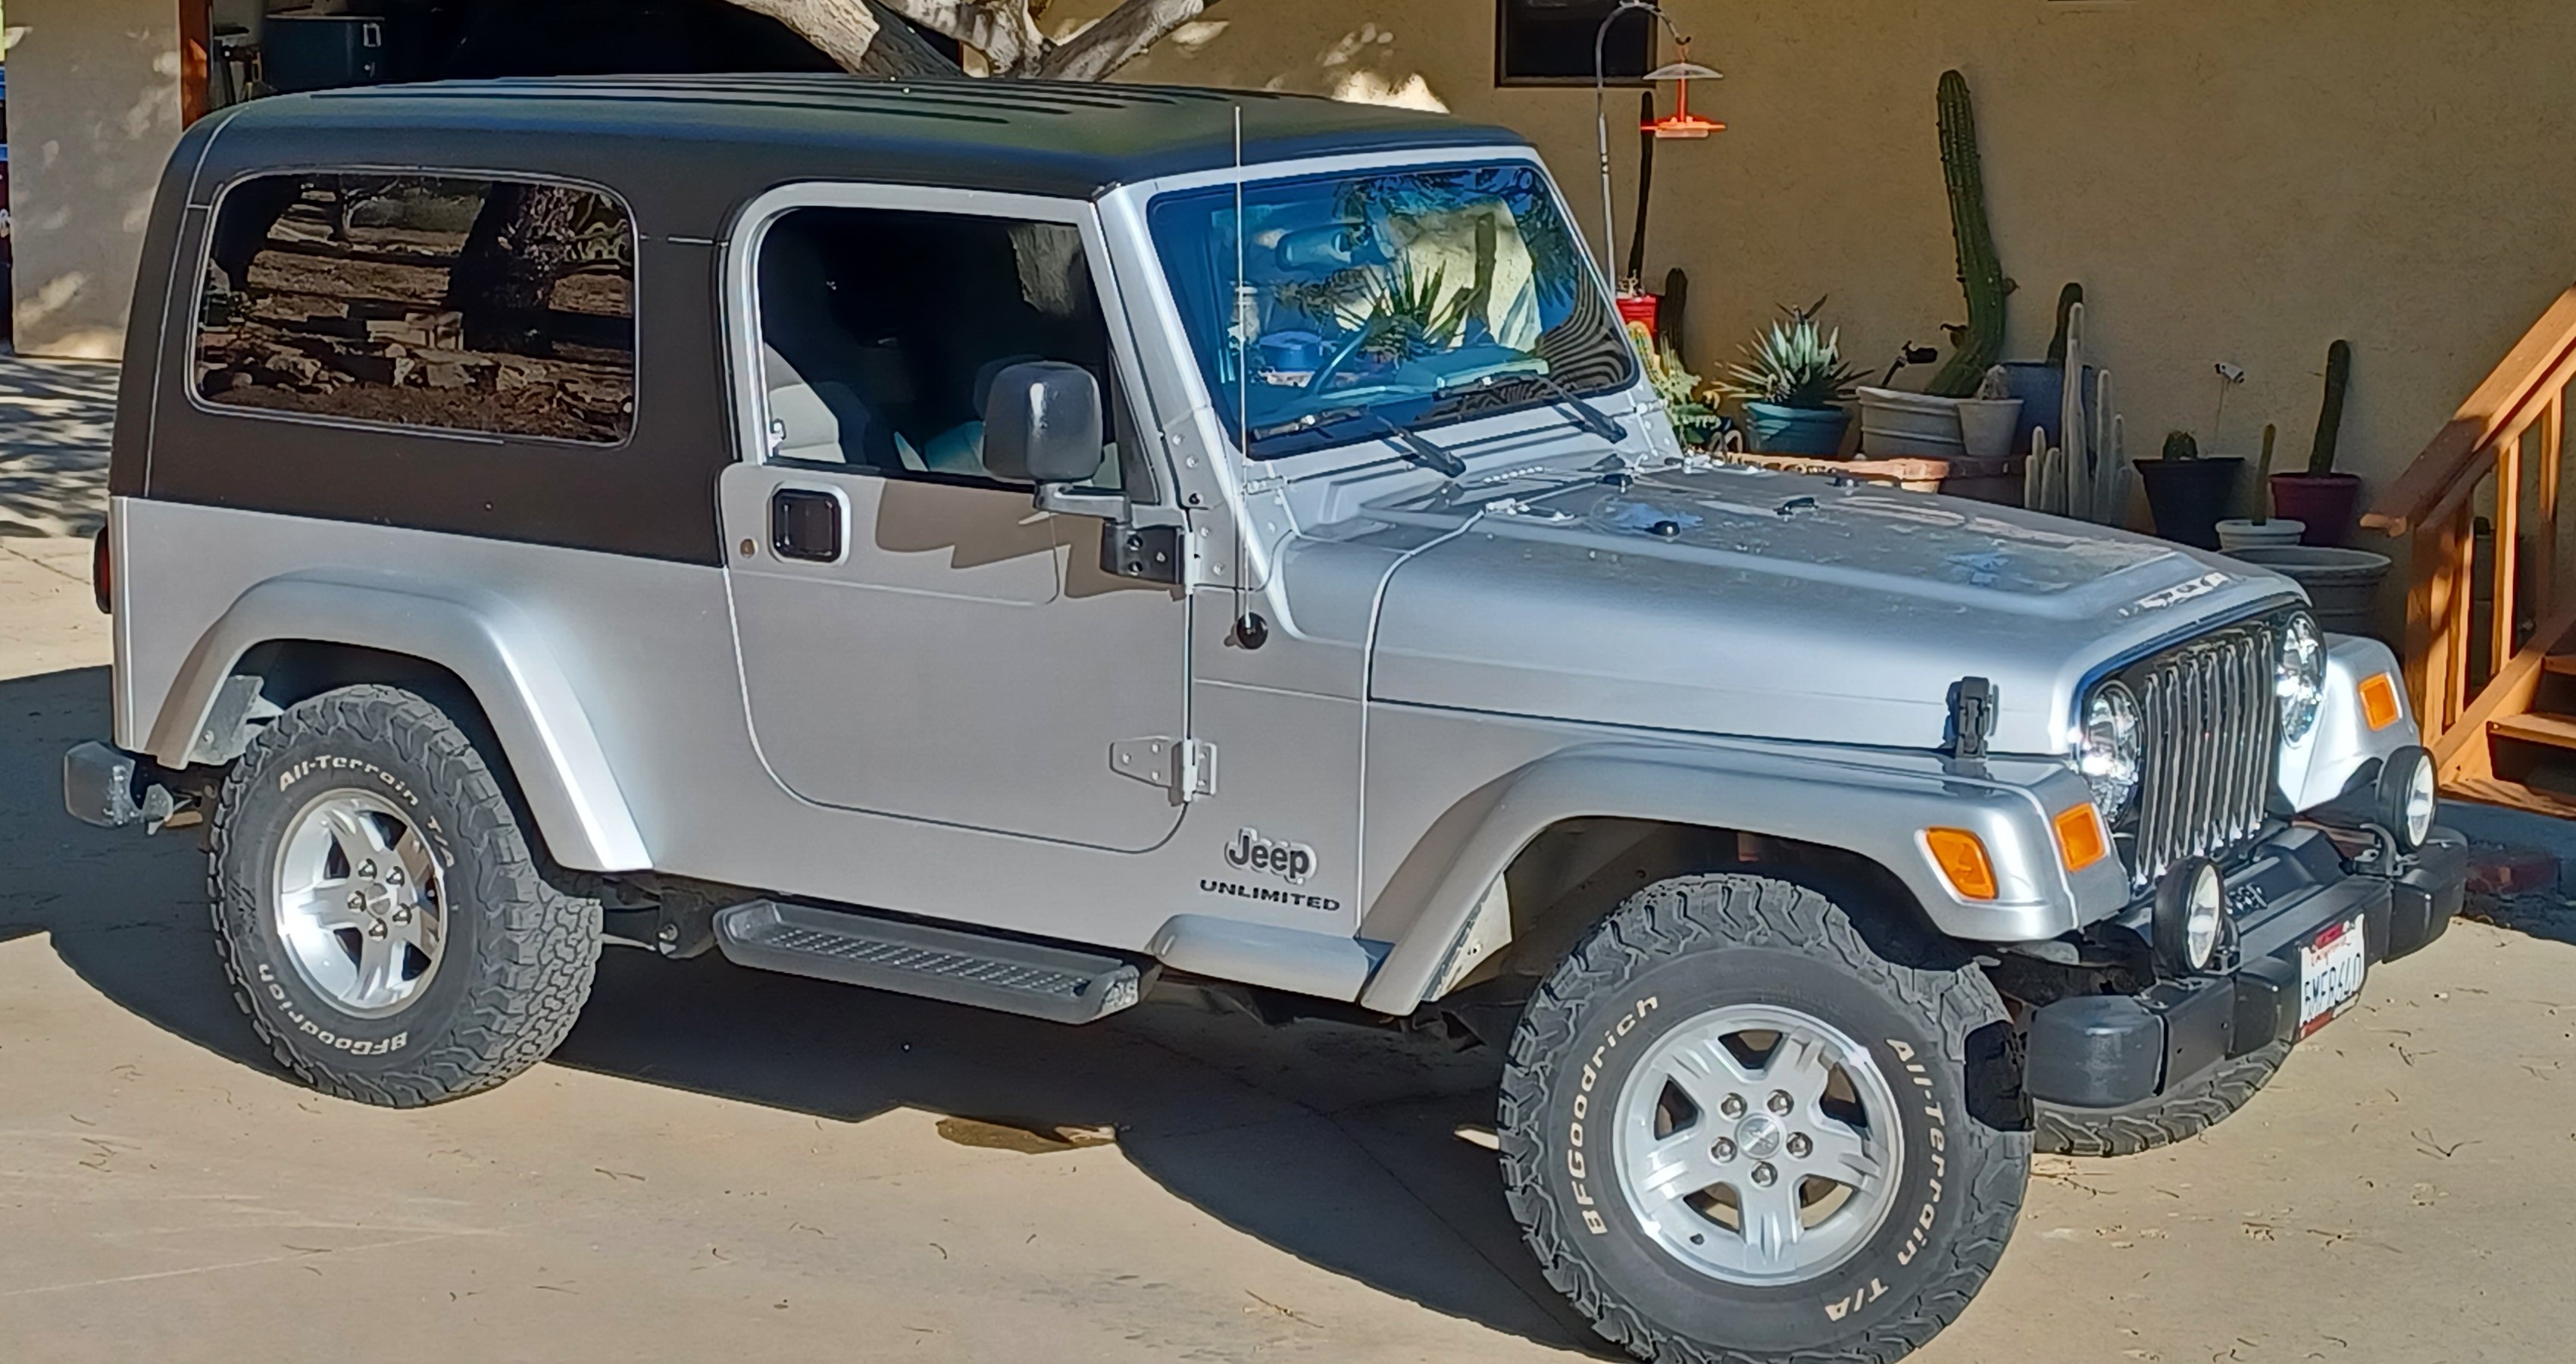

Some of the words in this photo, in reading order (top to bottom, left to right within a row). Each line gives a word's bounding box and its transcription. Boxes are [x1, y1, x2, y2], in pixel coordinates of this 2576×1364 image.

[279, 754, 419, 806] All-Terrain
[427, 815, 455, 868] T/A
[1226, 831, 1313, 882] Jeep
[1199, 879, 1340, 912] UNLIMITED
[258, 964, 408, 1056] BFGoodrich
[1568, 996, 1658, 1235] BFGoodrich
[1886, 1038, 1946, 1266] All-Terrain
[1824, 1277, 1890, 1322] T/A
